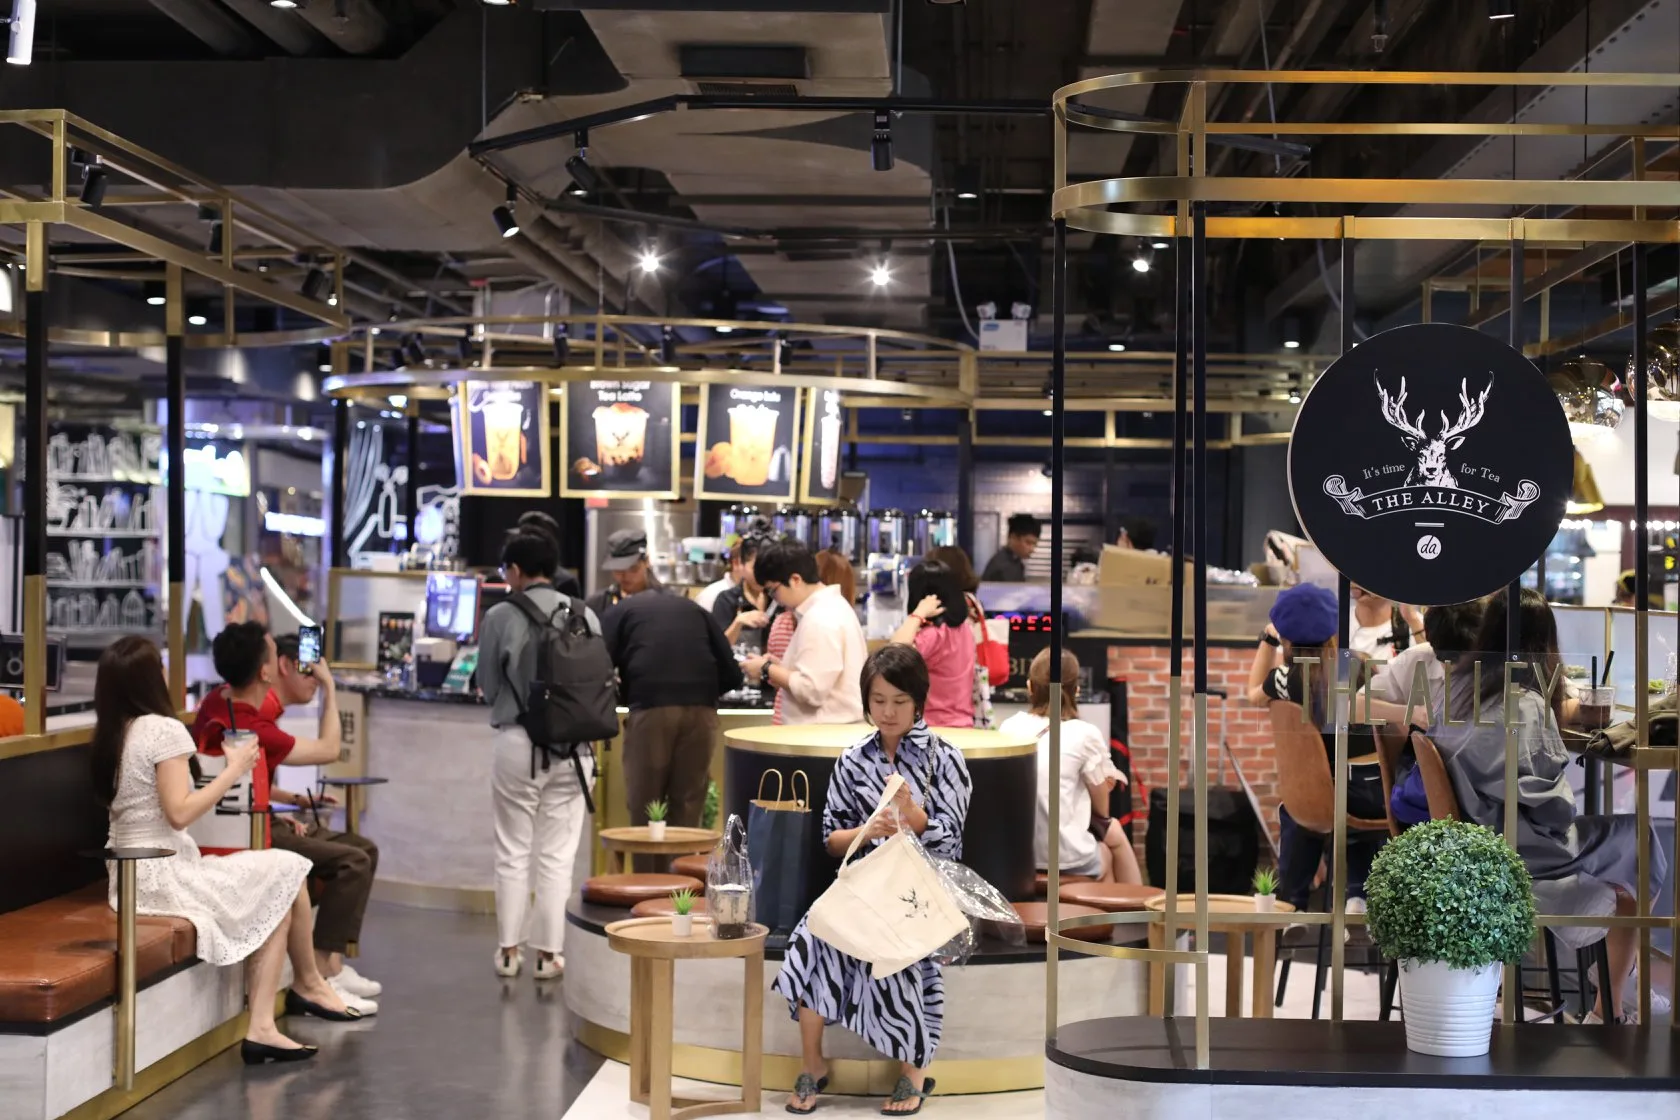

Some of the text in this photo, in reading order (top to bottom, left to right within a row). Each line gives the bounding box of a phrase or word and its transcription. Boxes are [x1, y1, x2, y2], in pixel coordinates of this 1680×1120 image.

[1363, 462, 1500, 482] It's time for Tea
[1372, 492, 1490, 513] THE ALLEY
[1292, 656, 1564, 729] THE ALLEY
